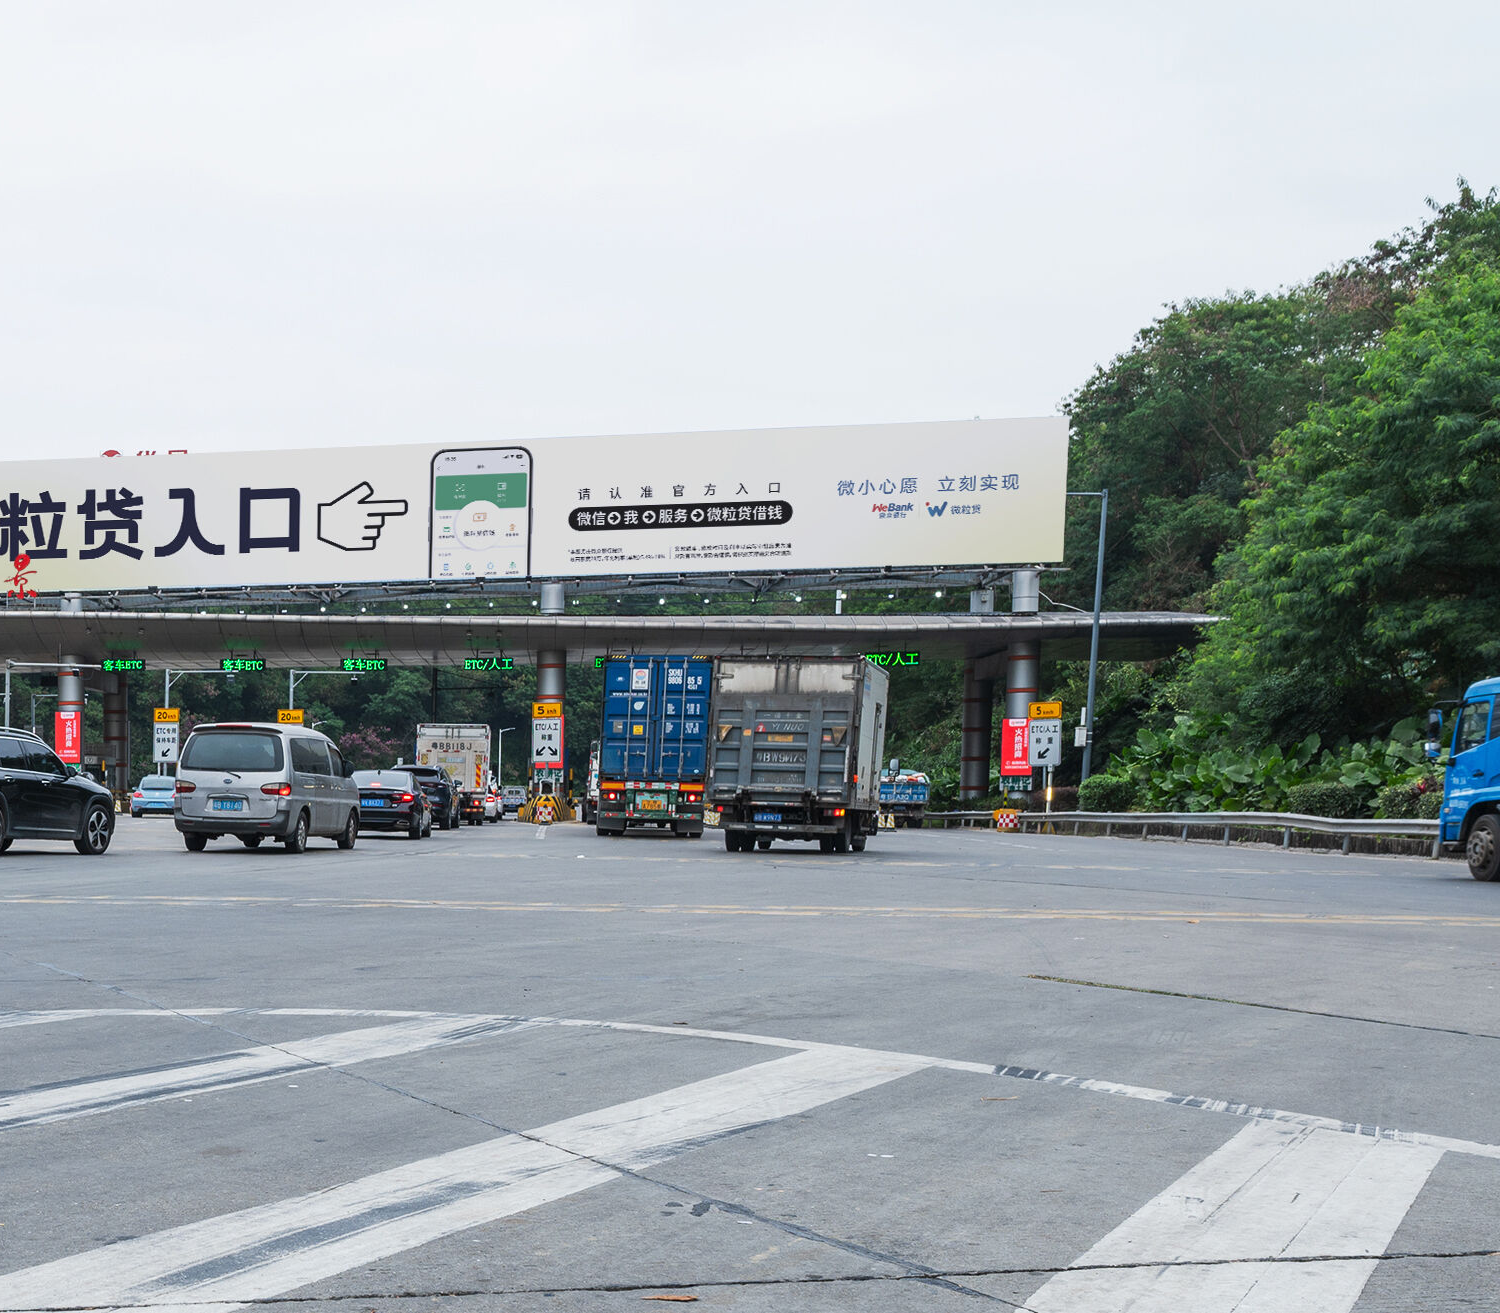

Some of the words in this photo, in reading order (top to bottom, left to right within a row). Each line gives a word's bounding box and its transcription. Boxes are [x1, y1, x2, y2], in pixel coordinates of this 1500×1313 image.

[837, 478, 917, 496] 微小心愿
[937, 473, 1020, 492] 立刻实现
[578, 482, 781, 501] 请认准官方入口
[872, 502, 914, 513] WeBank
[950, 504, 981, 515] 微粒贷
[577, 511, 605, 526] 微信
[623, 510, 639, 525] 我
[658, 508, 688, 524] 服务
[706, 505, 783, 522] 微粒贷借钱
[103, 659, 143, 671] 客车ETC
[223, 659, 263, 671] 客车ETC
[343, 658, 385, 671] 客车ETC
[464, 657, 513, 670] ETC/人工
[157, 711, 168, 720] 20
[537, 706, 545, 715] 5
[1036, 706, 1042, 716] 5
[281, 713, 292, 721] 20
